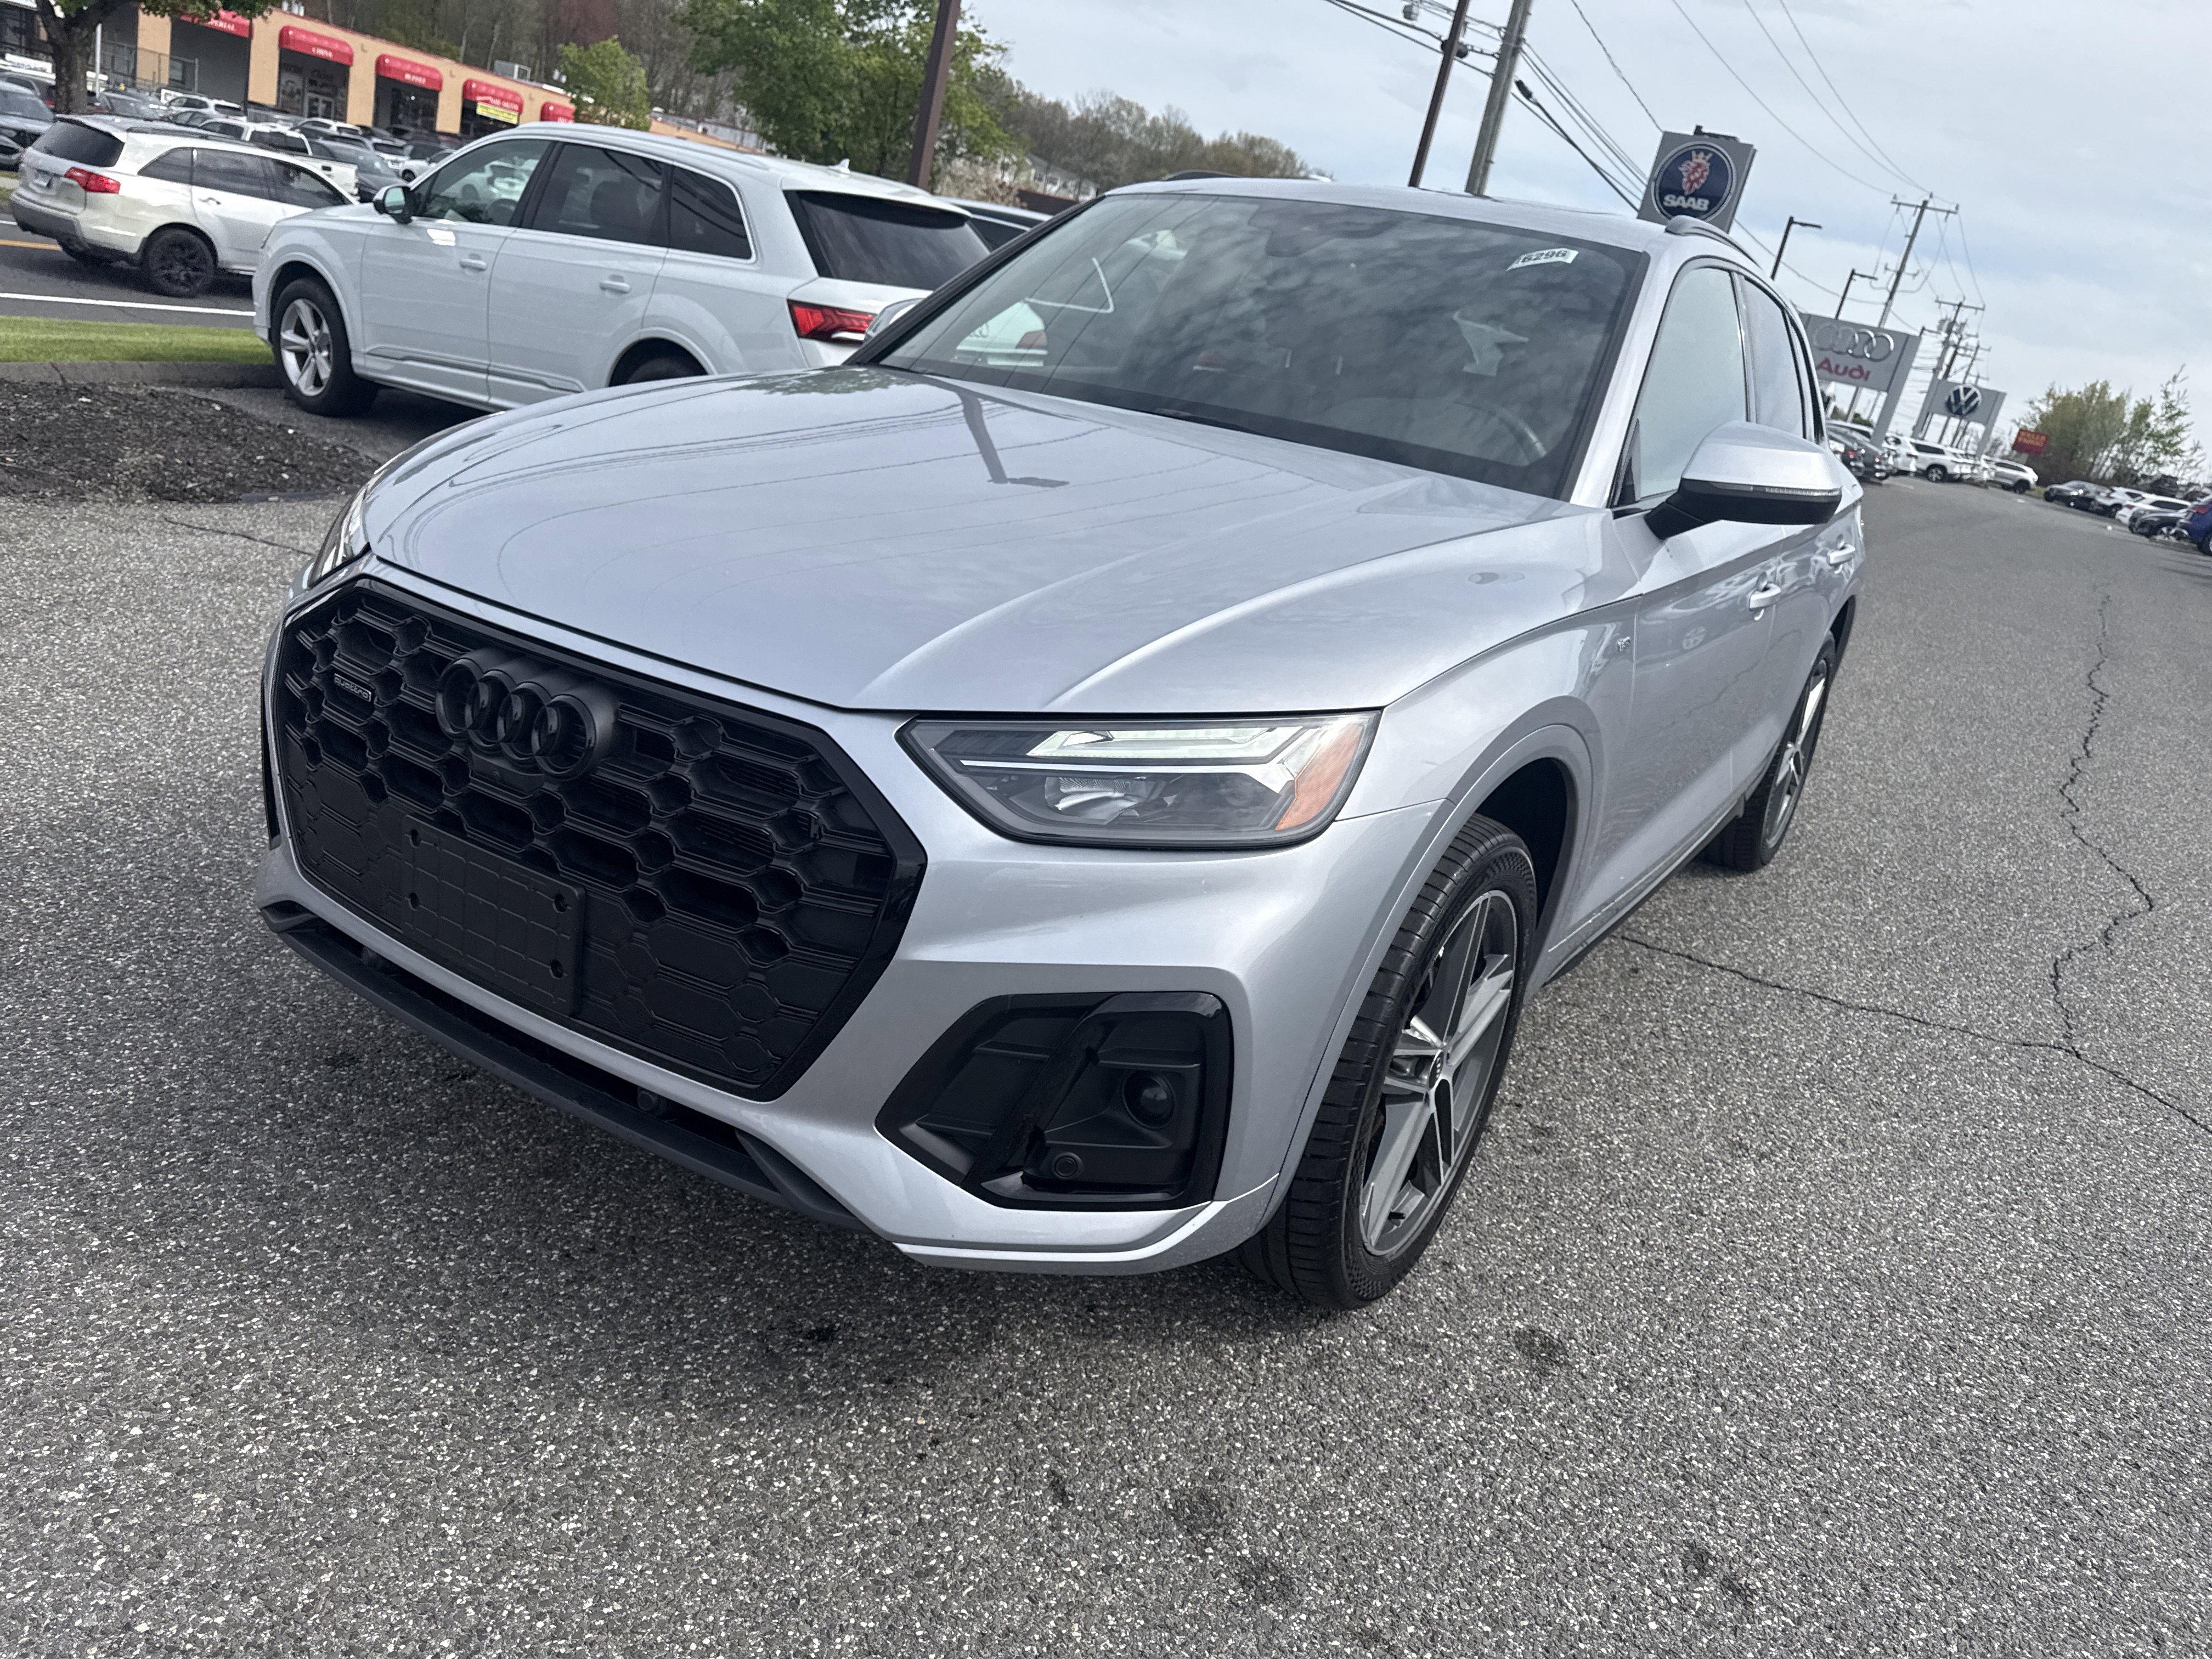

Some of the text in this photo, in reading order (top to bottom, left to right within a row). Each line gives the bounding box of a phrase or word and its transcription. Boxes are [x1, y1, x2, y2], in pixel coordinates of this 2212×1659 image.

[1663, 194, 1709, 211] SAAB
[1816, 357, 1871, 381] Audi
[334, 676, 369, 698] quattro
